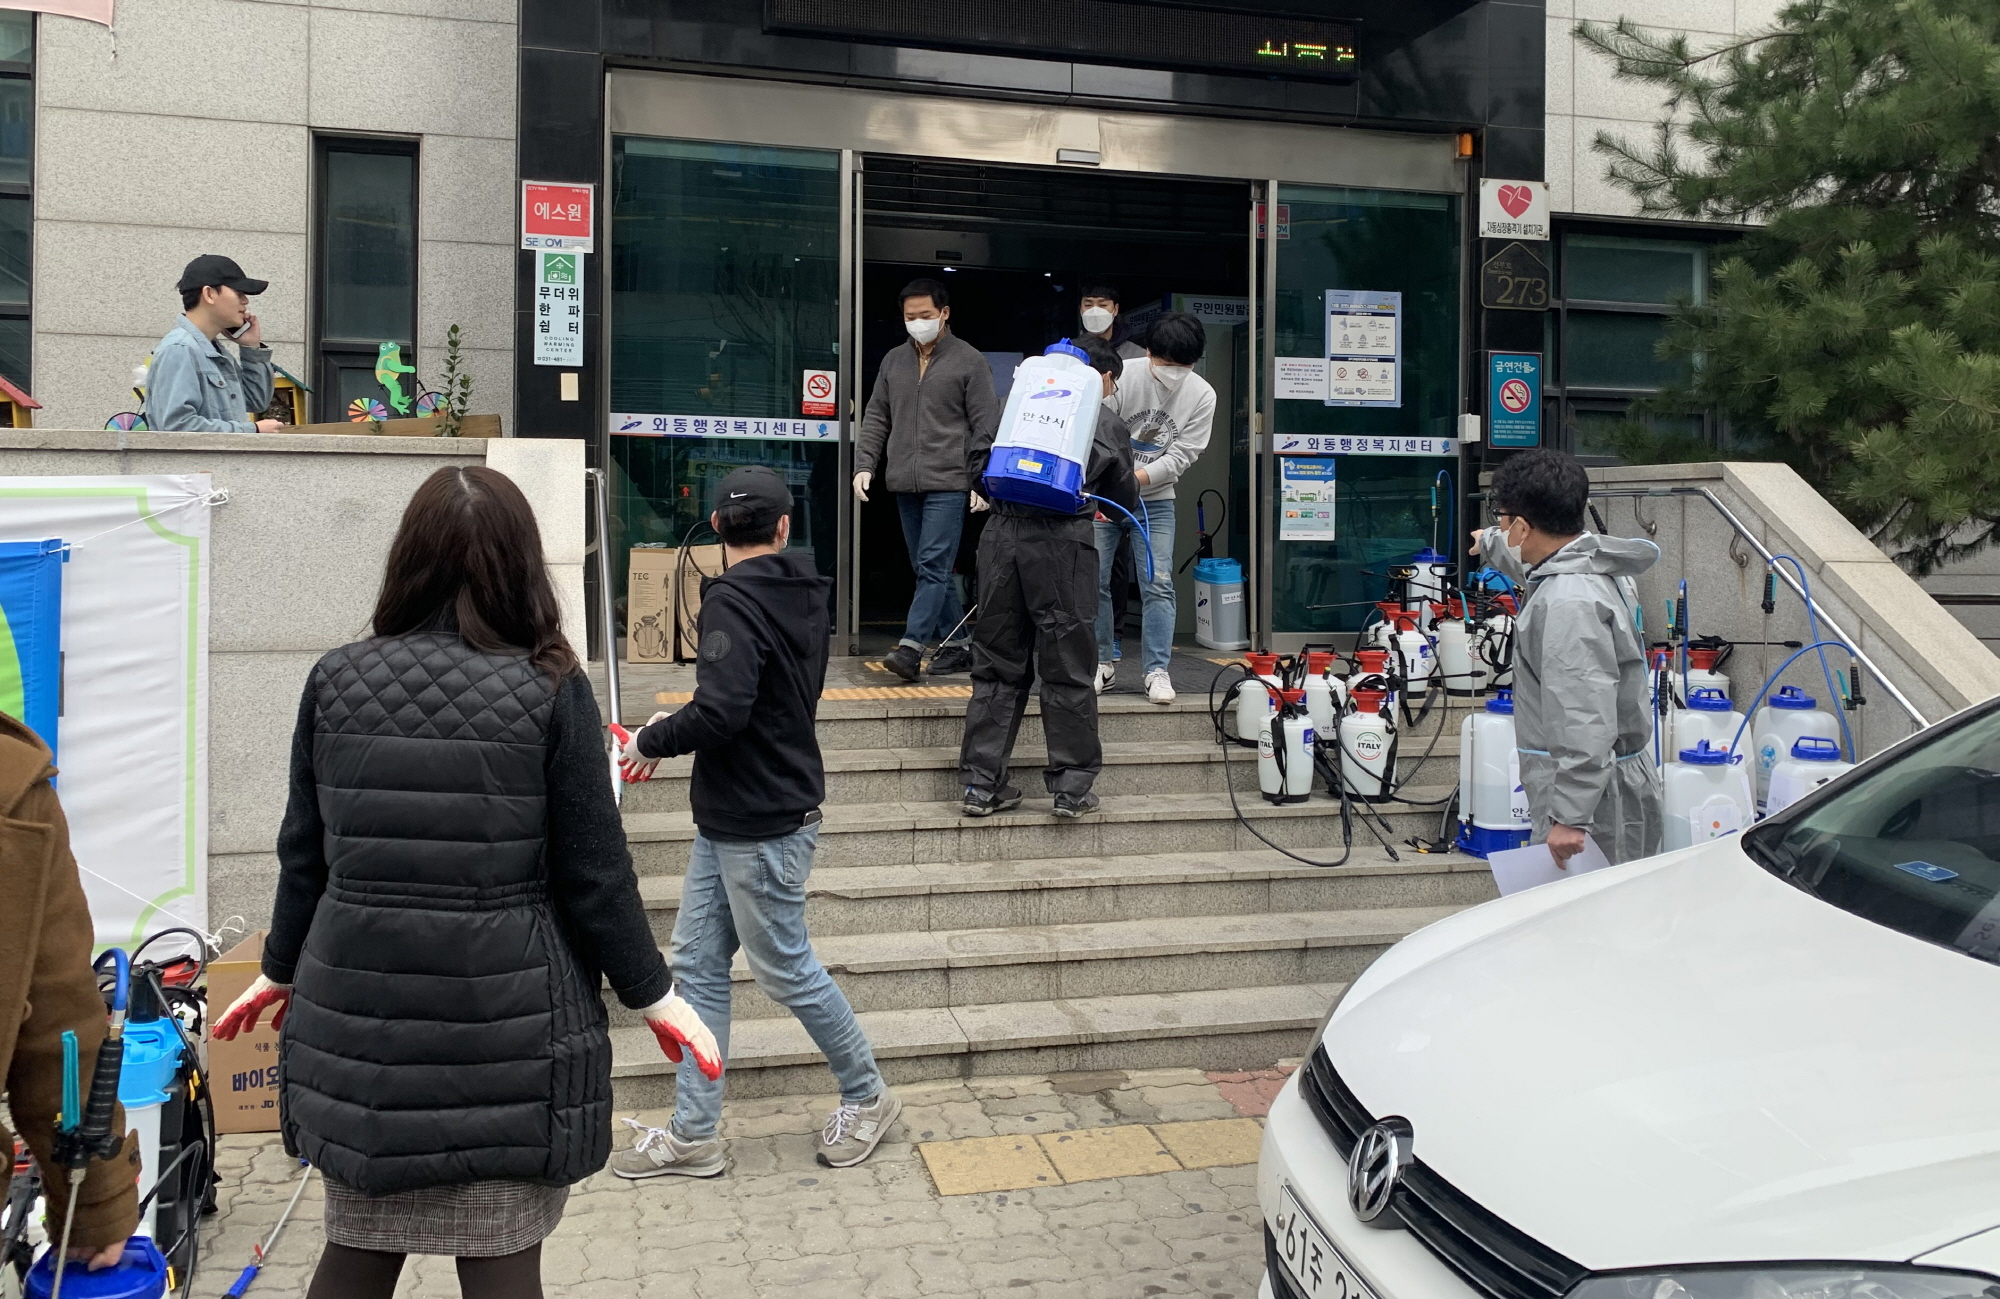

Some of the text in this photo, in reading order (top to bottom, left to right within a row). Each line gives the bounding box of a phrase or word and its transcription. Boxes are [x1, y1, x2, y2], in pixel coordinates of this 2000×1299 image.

[533, 202, 581, 222] 에스원
[1487, 221, 1543, 236] 자동심장충격기 설치기관
[525, 237, 562, 248] SECOM
[539, 286, 579, 301] 무더위
[1496, 275, 1547, 306] 273
[1495, 361, 1531, 374] 금연건물
[652, 416, 806, 437] 와동행정복지센터
[1023, 412, 1065, 429] 안산시
[1307, 437, 1432, 453] 와동행정복지센터
[632, 572, 649, 580] TEC
[1358, 742, 1381, 750] ITALY
[255, 1042, 270, 1052] 식품
[232, 1066, 279, 1092] 바이오
[261, 1100, 274, 1108] JD
[648, 1144, 675, 1167] N
[1286, 1212, 1361, 1299] 61주 2
